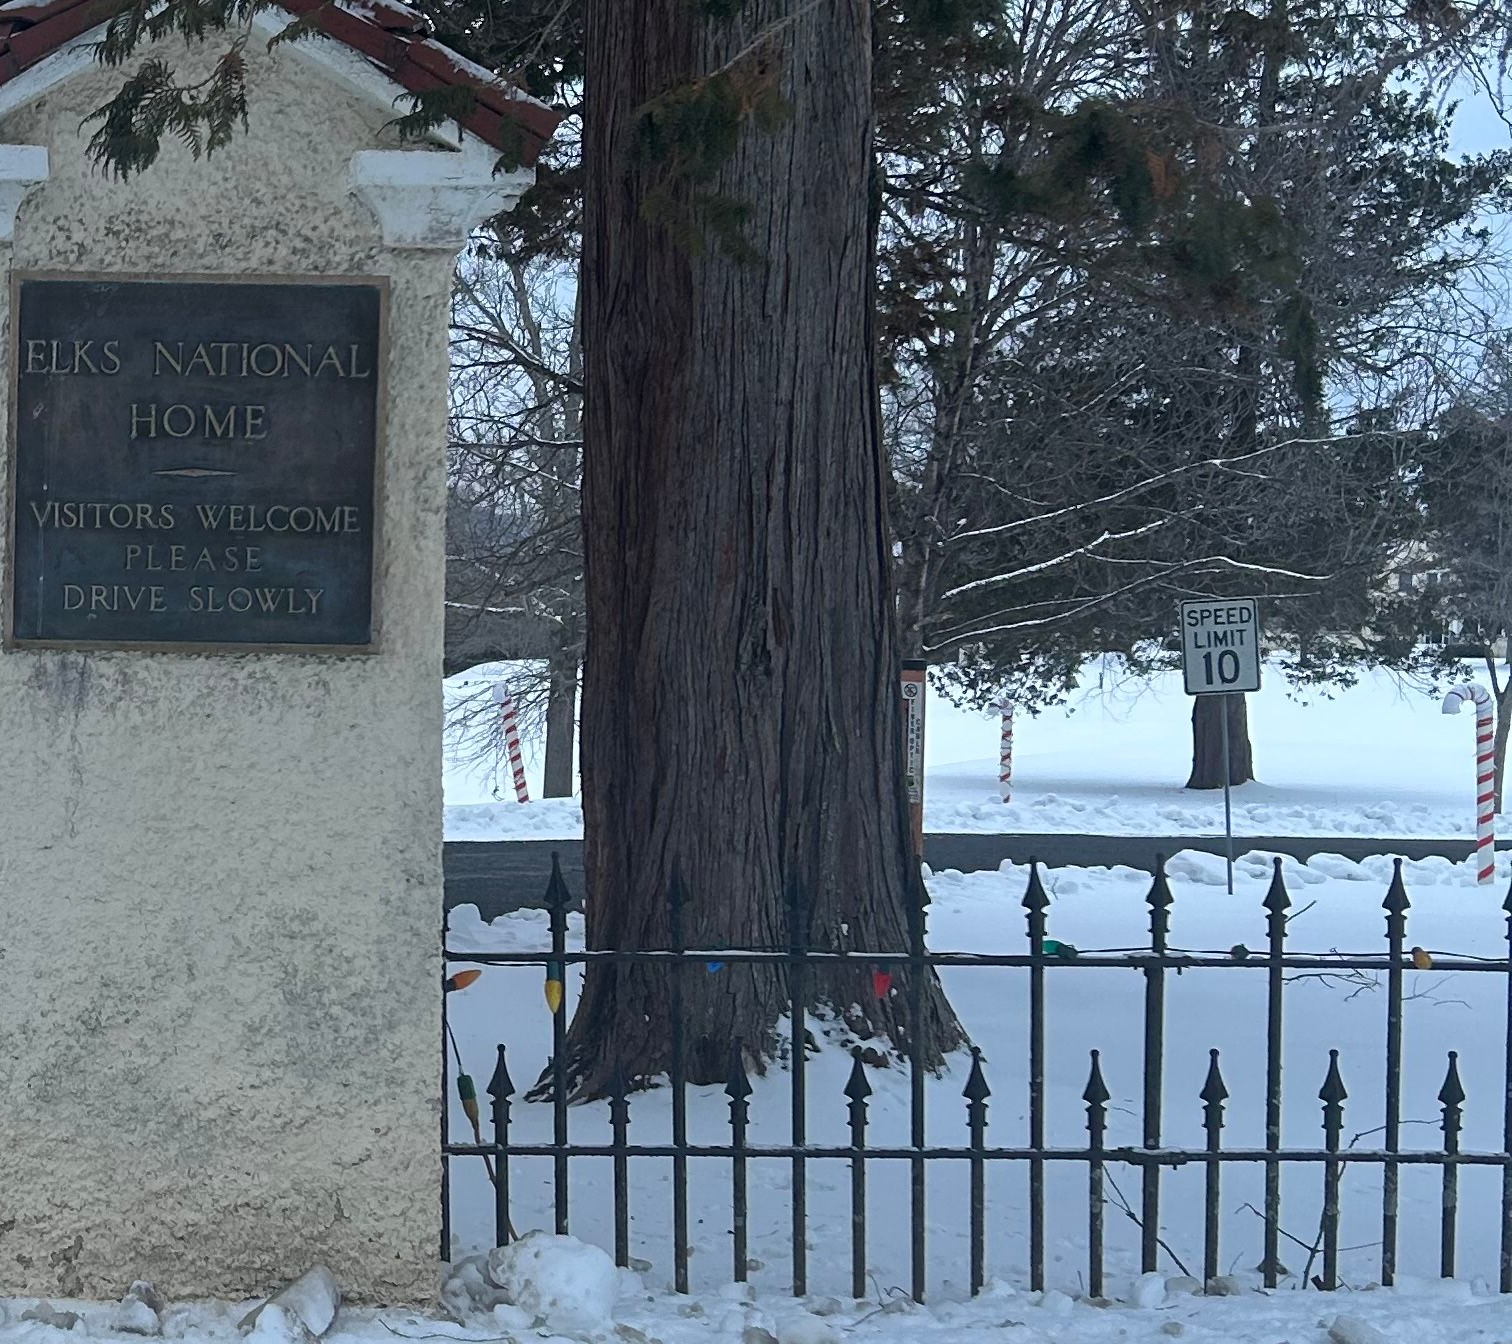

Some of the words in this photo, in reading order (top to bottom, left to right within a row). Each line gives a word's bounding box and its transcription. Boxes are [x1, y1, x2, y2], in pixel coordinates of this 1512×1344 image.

[25, 339, 122, 375] ELKS
[153, 342, 371, 379] NATIONAL
[129, 403, 268, 440] HOME
[30, 501, 176, 530] VISITORS
[196, 504, 361, 533] WELCOME
[125, 544, 263, 573] PLEASE
[63, 584, 168, 612] DRIVE
[189, 586, 325, 615] SLOWLY
[1187, 607, 1252, 627] SPEED
[1194, 629, 1246, 649] LIMIT
[1202, 649, 1241, 685] 10
